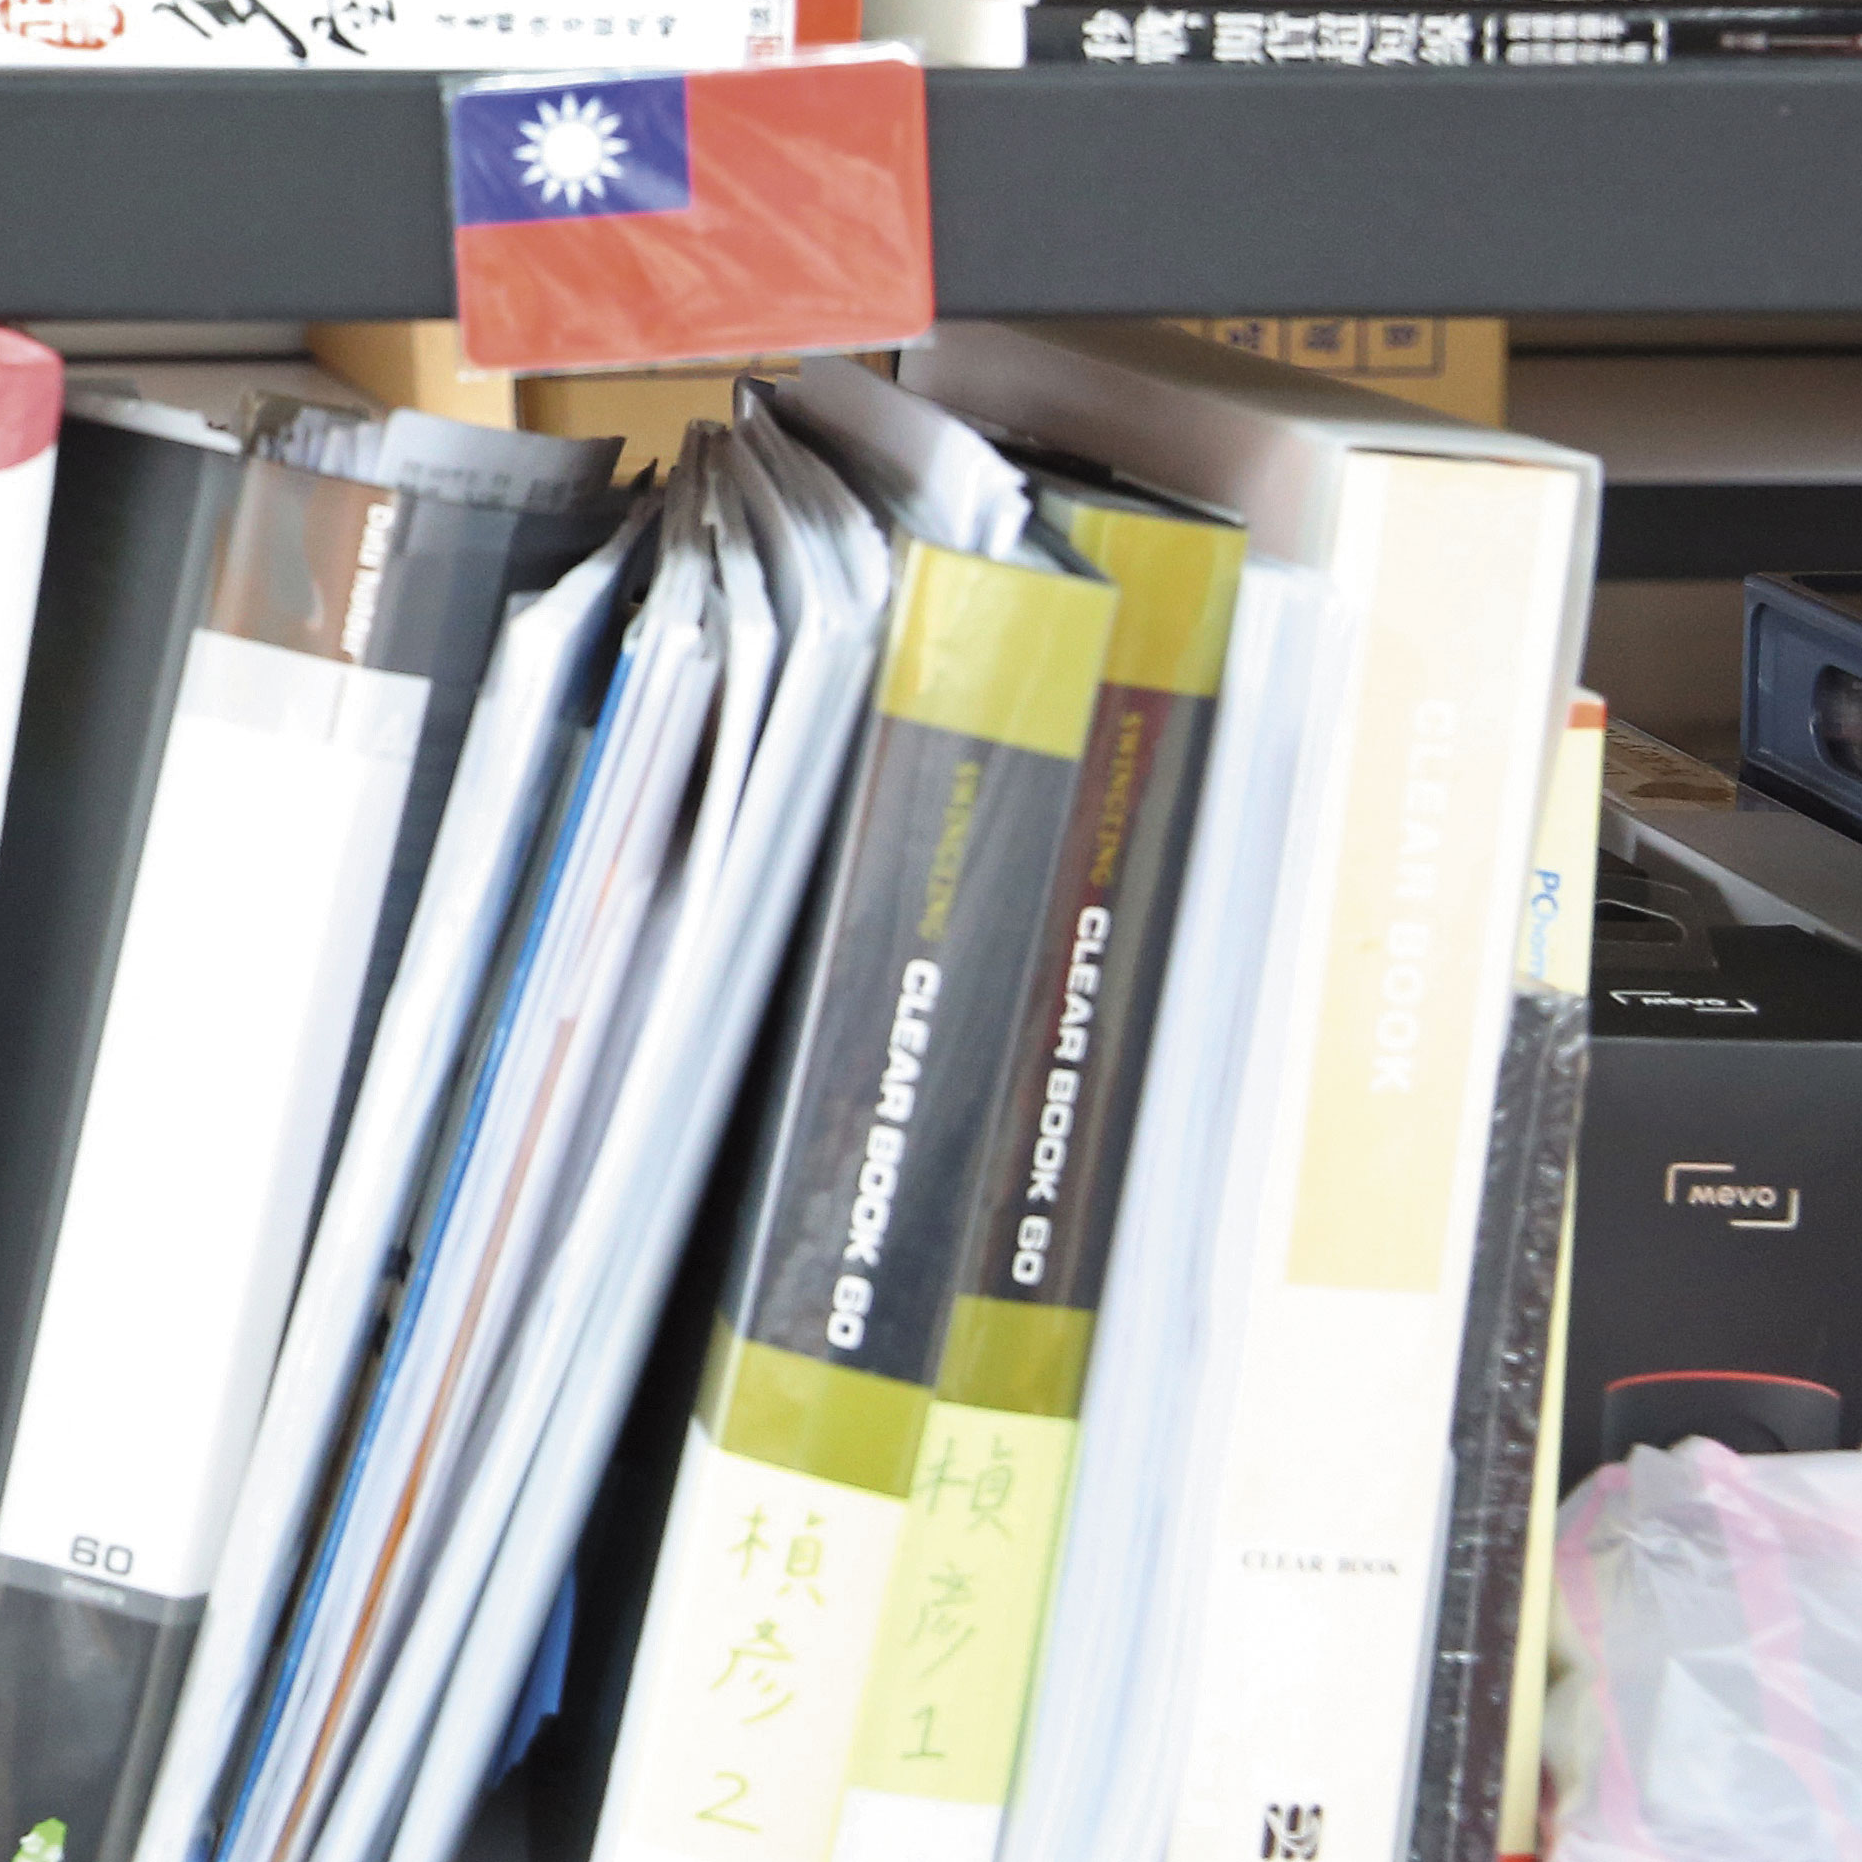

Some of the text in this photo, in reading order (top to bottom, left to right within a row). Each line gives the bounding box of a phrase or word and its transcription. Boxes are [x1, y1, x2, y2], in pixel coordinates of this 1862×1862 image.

[1053, 906, 1111, 1062] CLEAR
[877, 958, 943, 1120] CLEAR
[1026, 1069, 1082, 1204] BOOK
[843, 1124, 906, 1268] BOOK
[1011, 1214, 1053, 1286] 60
[826, 1275, 875, 1351] 60
[72, 1536, 133, 1575] 60
[1240, 1550, 1402, 1579] CLEAR BOOK
